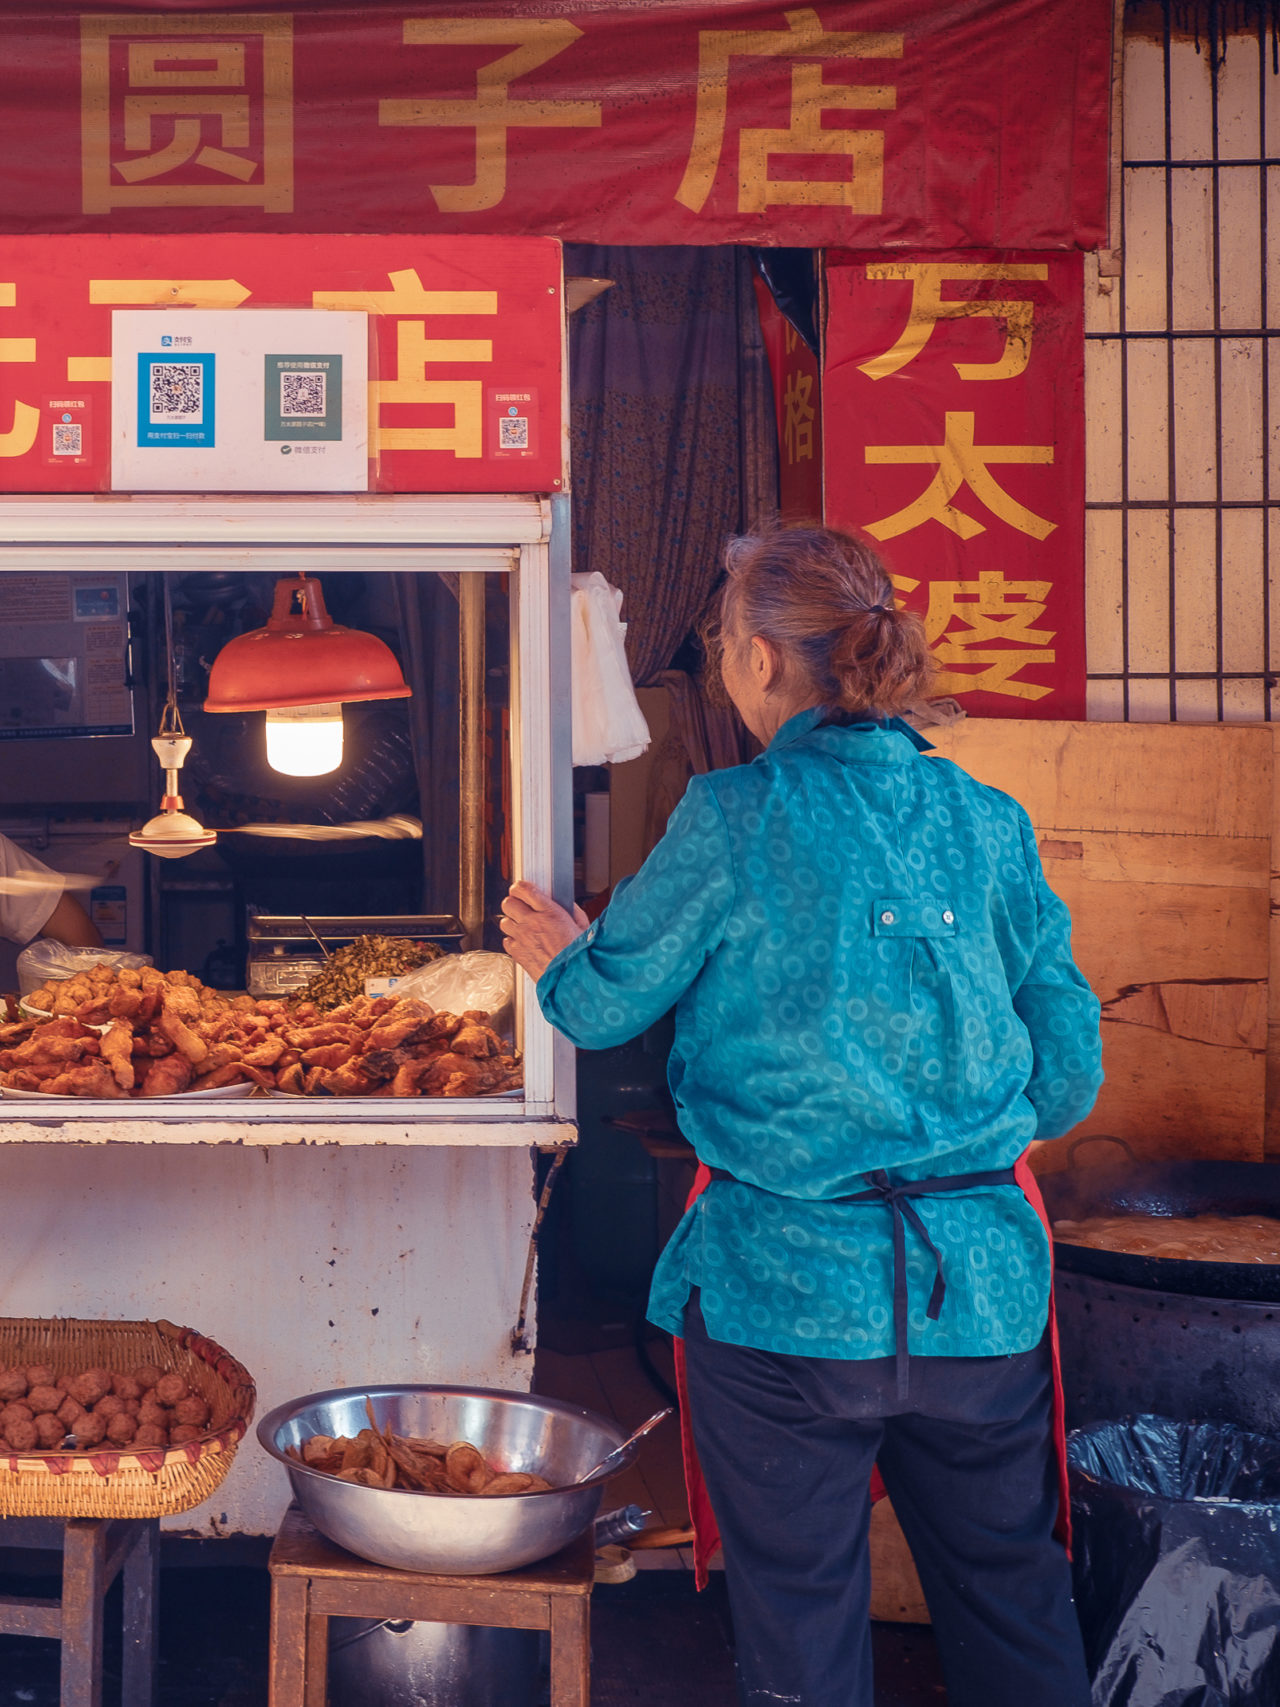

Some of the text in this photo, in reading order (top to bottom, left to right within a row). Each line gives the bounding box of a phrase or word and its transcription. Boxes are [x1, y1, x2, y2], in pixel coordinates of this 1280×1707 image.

[294, 446, 326, 455] 微信支付
[856, 262, 1059, 701] 万太婆
